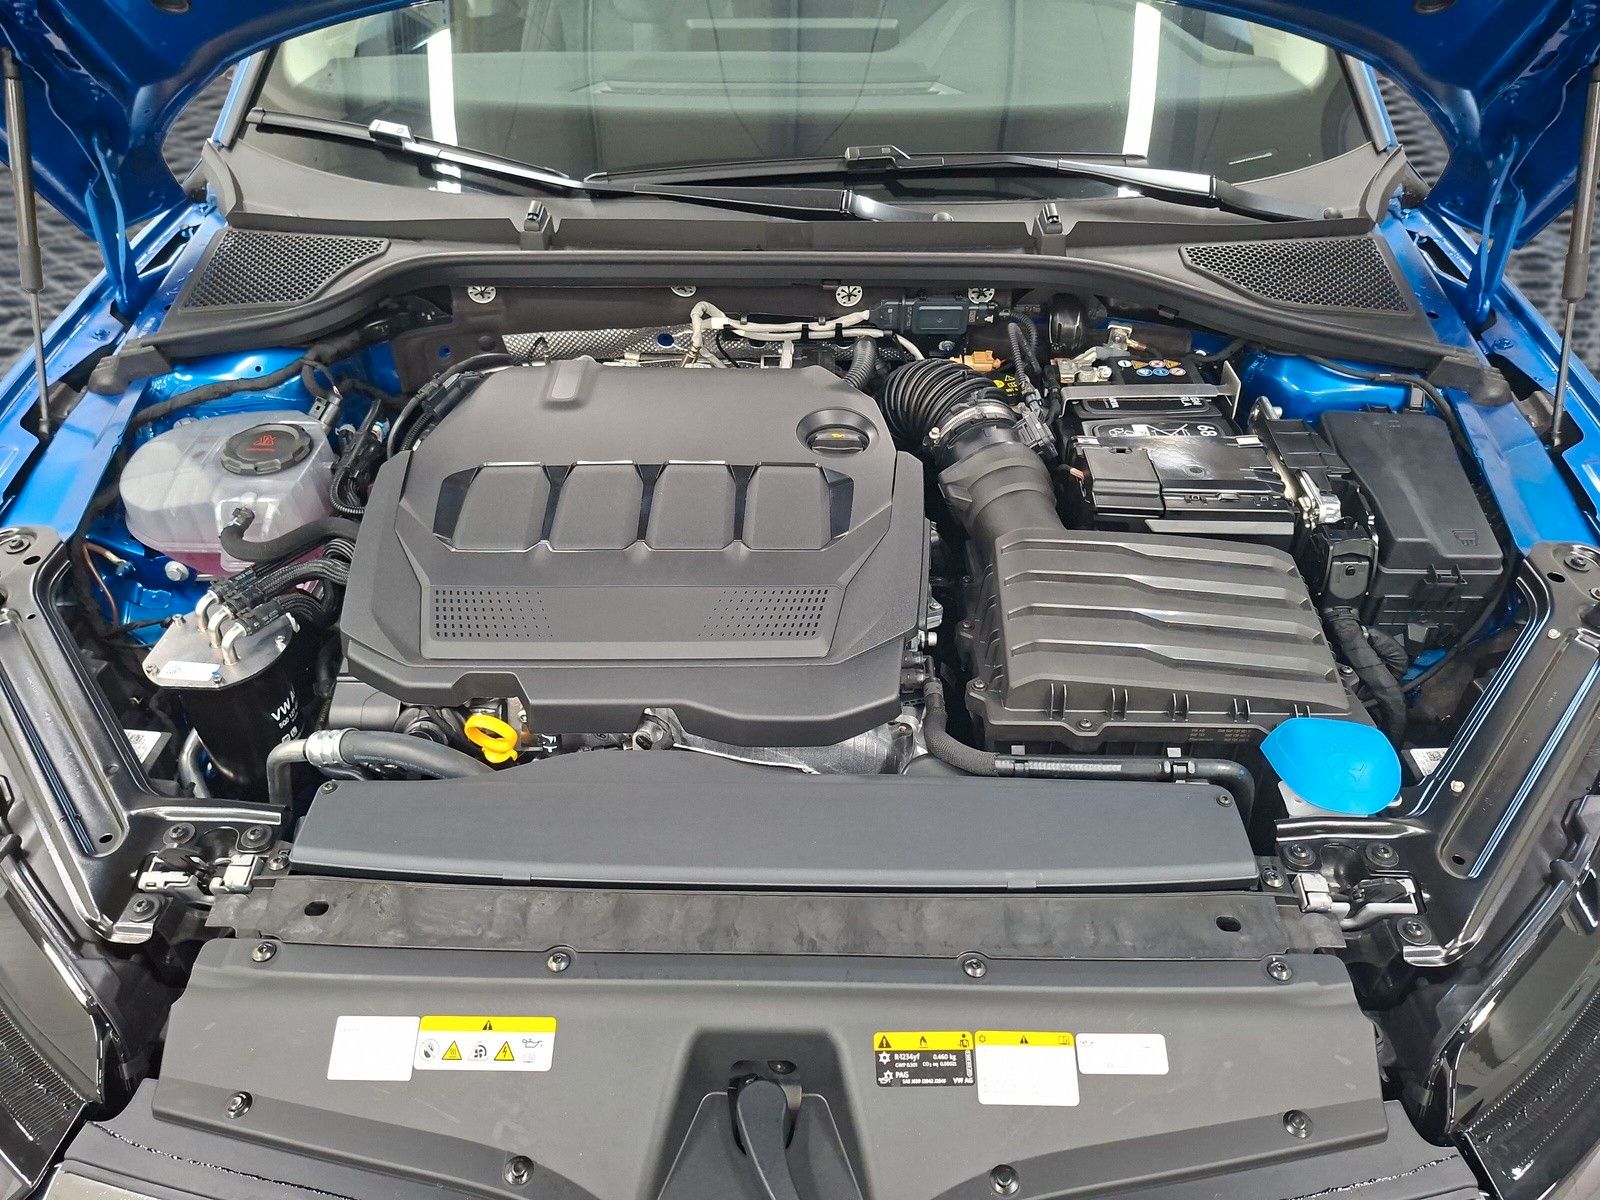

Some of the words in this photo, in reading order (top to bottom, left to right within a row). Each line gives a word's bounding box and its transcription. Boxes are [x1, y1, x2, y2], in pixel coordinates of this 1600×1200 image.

[1197, 424, 1218, 437] 68
[271, 697, 290, 721] VW
[894, 1053, 920, 1062] R-1234yf
[949, 1053, 957, 1061] kg
[895, 1071, 909, 1079] PAG
